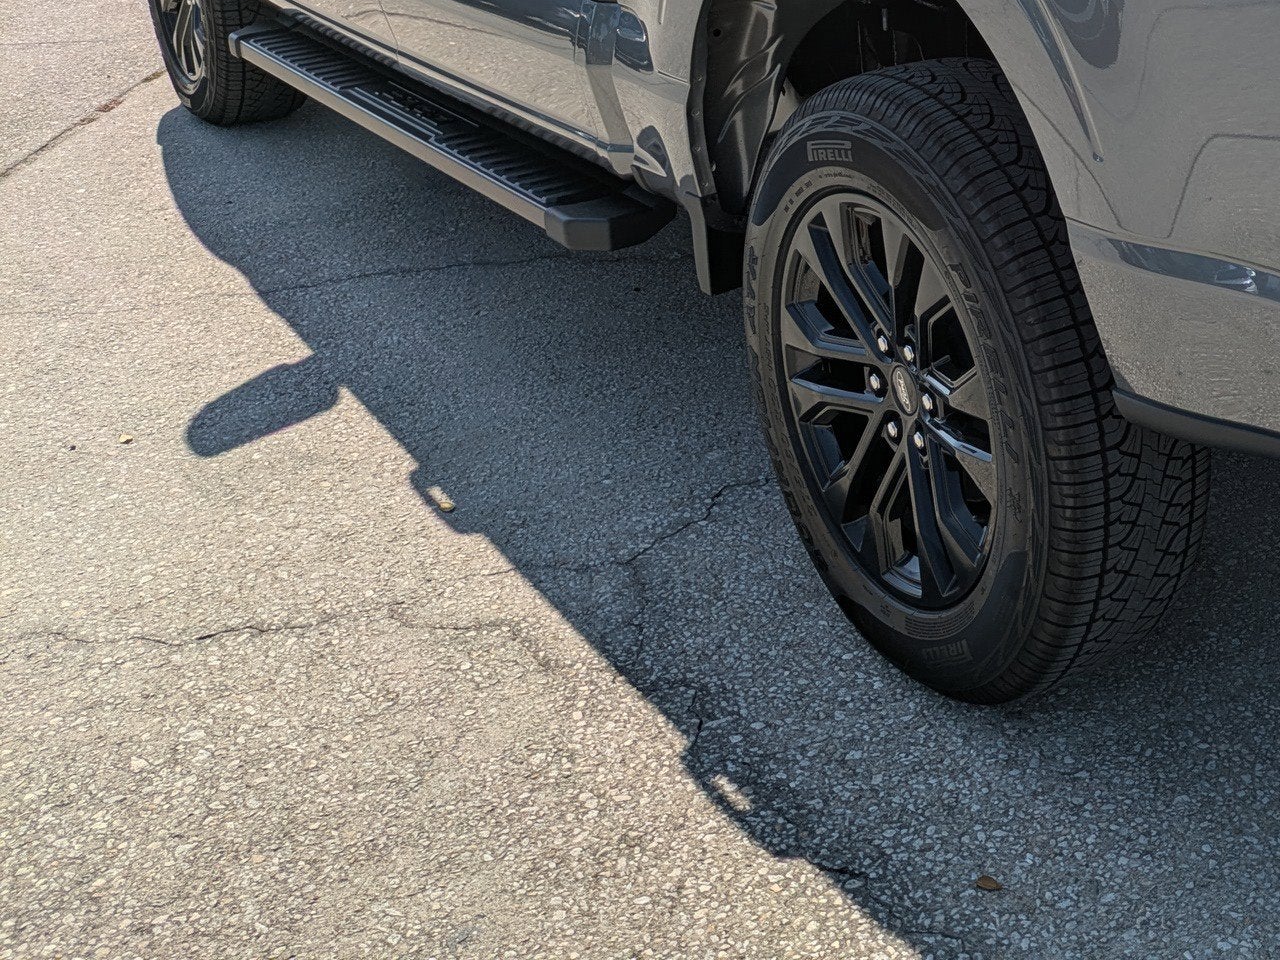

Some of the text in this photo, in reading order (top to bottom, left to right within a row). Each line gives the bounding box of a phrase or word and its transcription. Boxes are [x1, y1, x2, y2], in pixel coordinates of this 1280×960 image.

[806, 139, 854, 163] PIRELLI
[947, 263, 1019, 464] PIRELLI
[920, 638, 973, 665] PIRELLI
